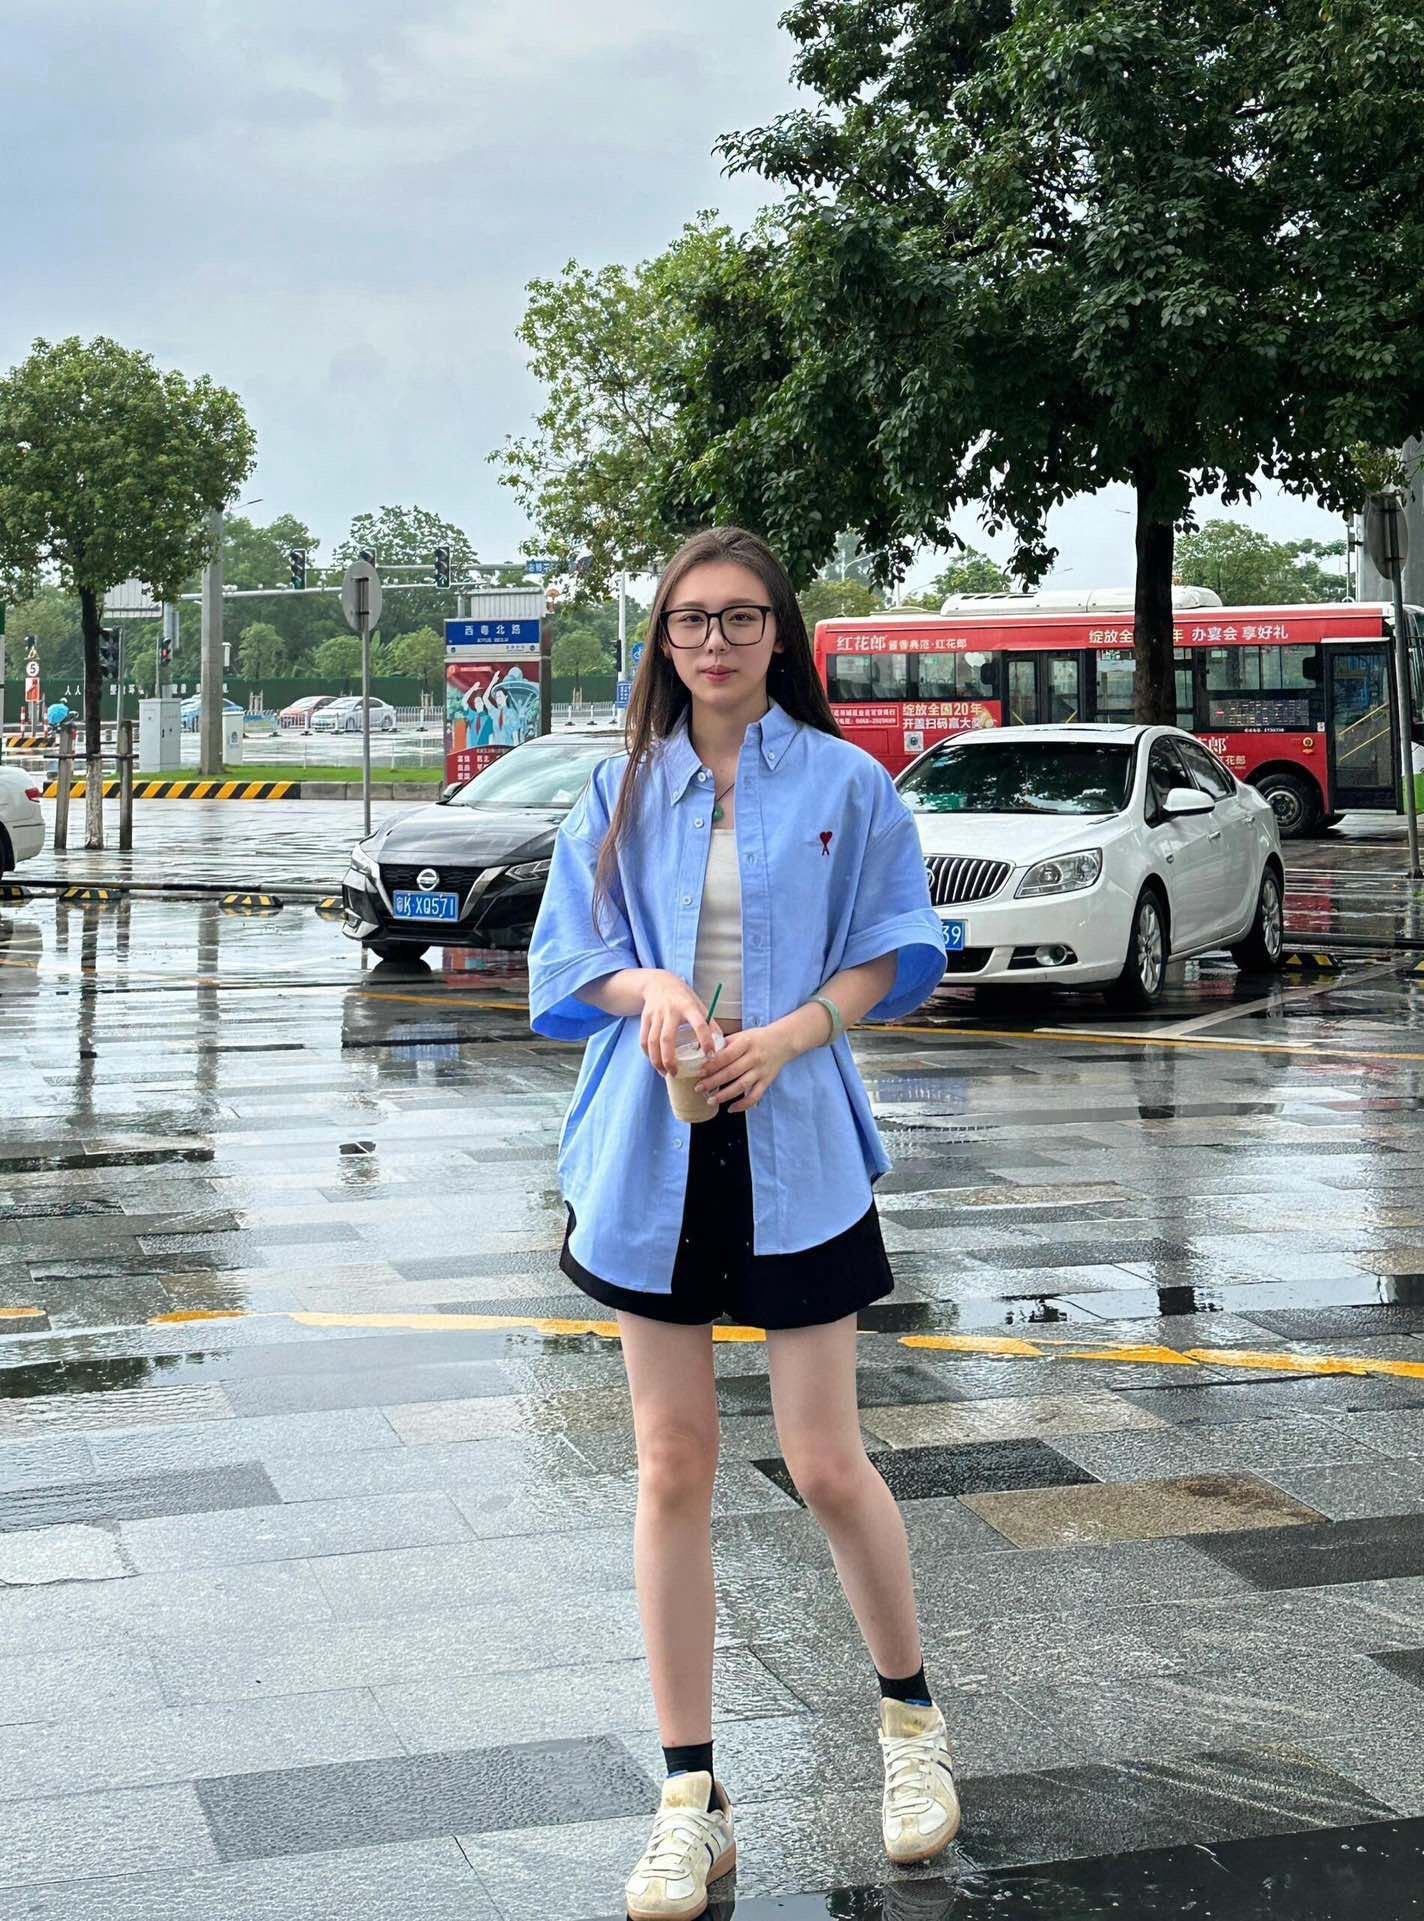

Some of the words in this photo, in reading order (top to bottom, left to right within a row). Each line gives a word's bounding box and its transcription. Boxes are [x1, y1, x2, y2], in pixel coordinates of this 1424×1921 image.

[1192, 627, 1238, 641] 办宴会
[1242, 624, 1288, 639] 享好礼
[836, 635, 886, 651] 红花郎
